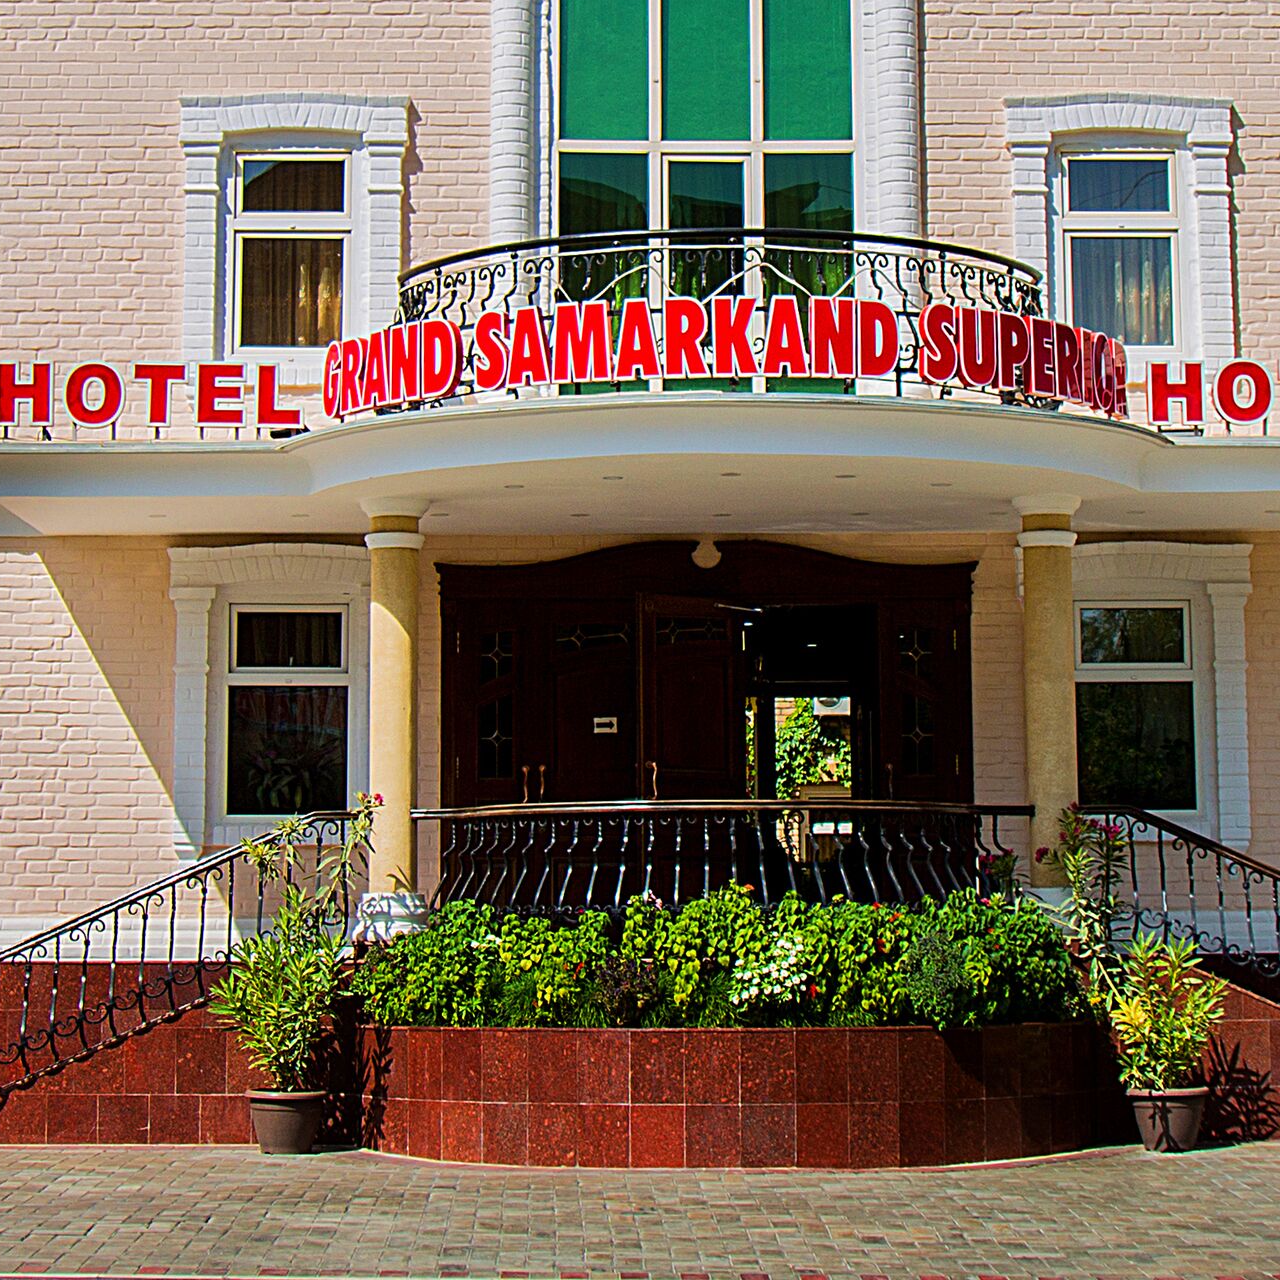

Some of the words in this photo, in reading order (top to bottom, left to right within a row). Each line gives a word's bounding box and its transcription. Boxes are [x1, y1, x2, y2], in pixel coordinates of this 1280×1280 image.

[321, 319, 462, 418] GRAND
[475, 297, 901, 390] SAMARKAND
[918, 303, 1128, 419] SUPERIOR
